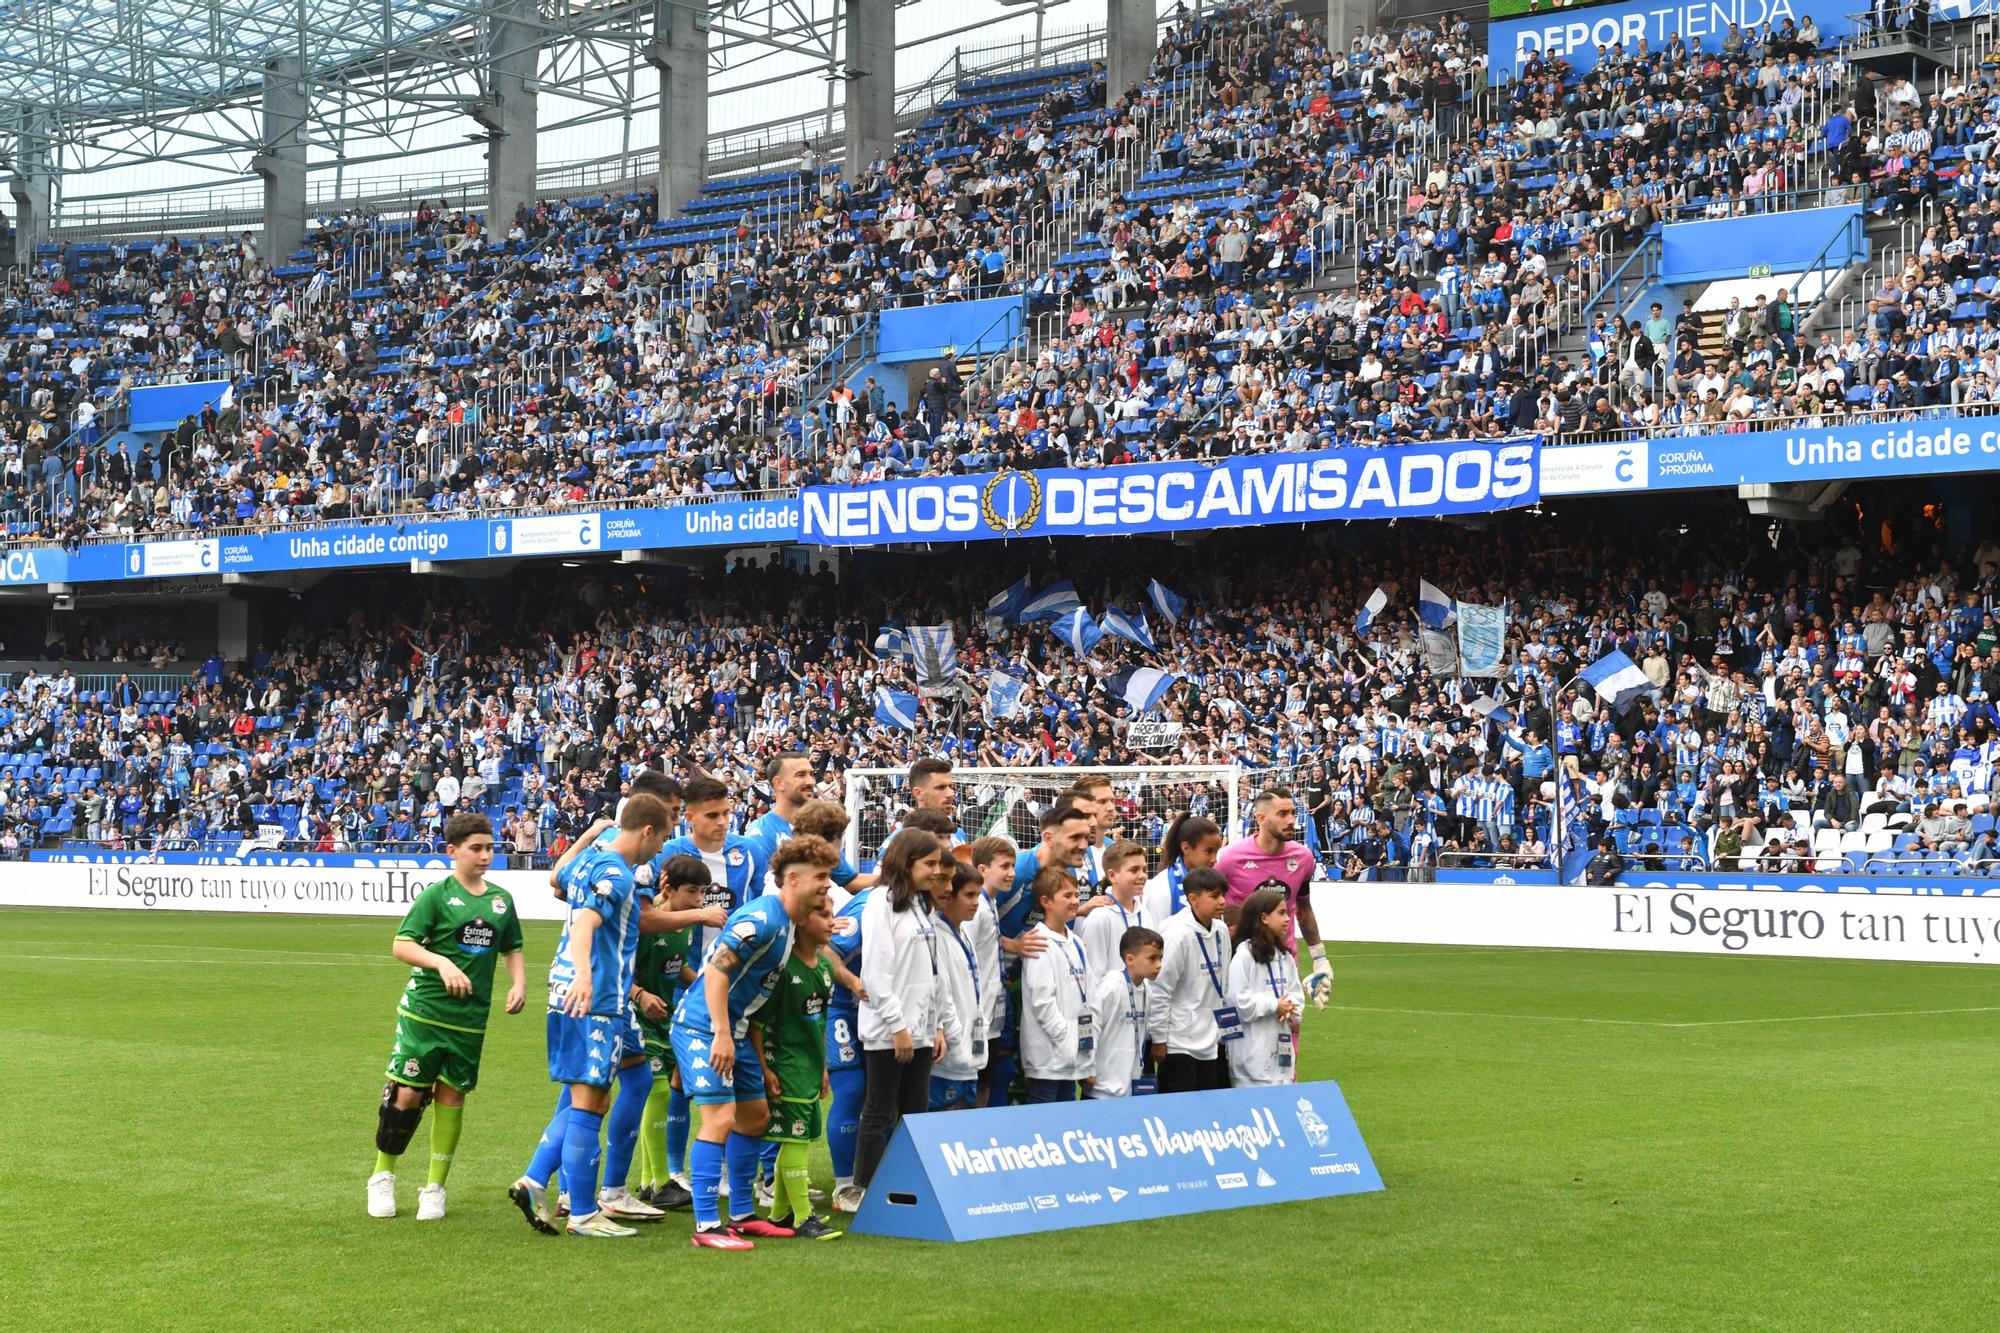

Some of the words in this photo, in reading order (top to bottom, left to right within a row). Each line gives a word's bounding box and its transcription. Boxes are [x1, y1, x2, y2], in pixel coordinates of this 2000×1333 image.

[1659, 450, 1703, 464] CORUÑA
[1786, 436, 1862, 465] Unha
[1871, 428, 1971, 460] cidade
[803, 486, 978, 536] NENOS
[1046, 446, 1533, 526] DESCAMISADOS
[607, 519, 636, 529] CORUÑA
[686, 511, 733, 534] Unha
[738, 506, 798, 531] cidade
[224, 544, 248, 554] CORUÑA
[290, 538, 329, 558] Unha
[334, 533, 385, 555] cidade
[389, 529, 448, 554] contigo
[88, 867, 108, 896] El
[117, 867, 193, 906] Seguro
[201, 877, 232, 899] tan
[240, 878, 286, 908] tuyo
[294, 879, 354, 902] como
[464, 926, 493, 937] Estrella
[1612, 893, 1651, 934] El
[1670, 892, 1825, 951] Seguro
[1841, 909, 1905, 943] tan
[1923, 912, 2000, 957] tuy
[463, 935, 490, 946] Galicia
[834, 1019, 850, 1044] 8
[940, 1133, 1066, 1176] Marineda
[1063, 1129, 1118, 1169] City
[1118, 1132, 1148, 1158] es
